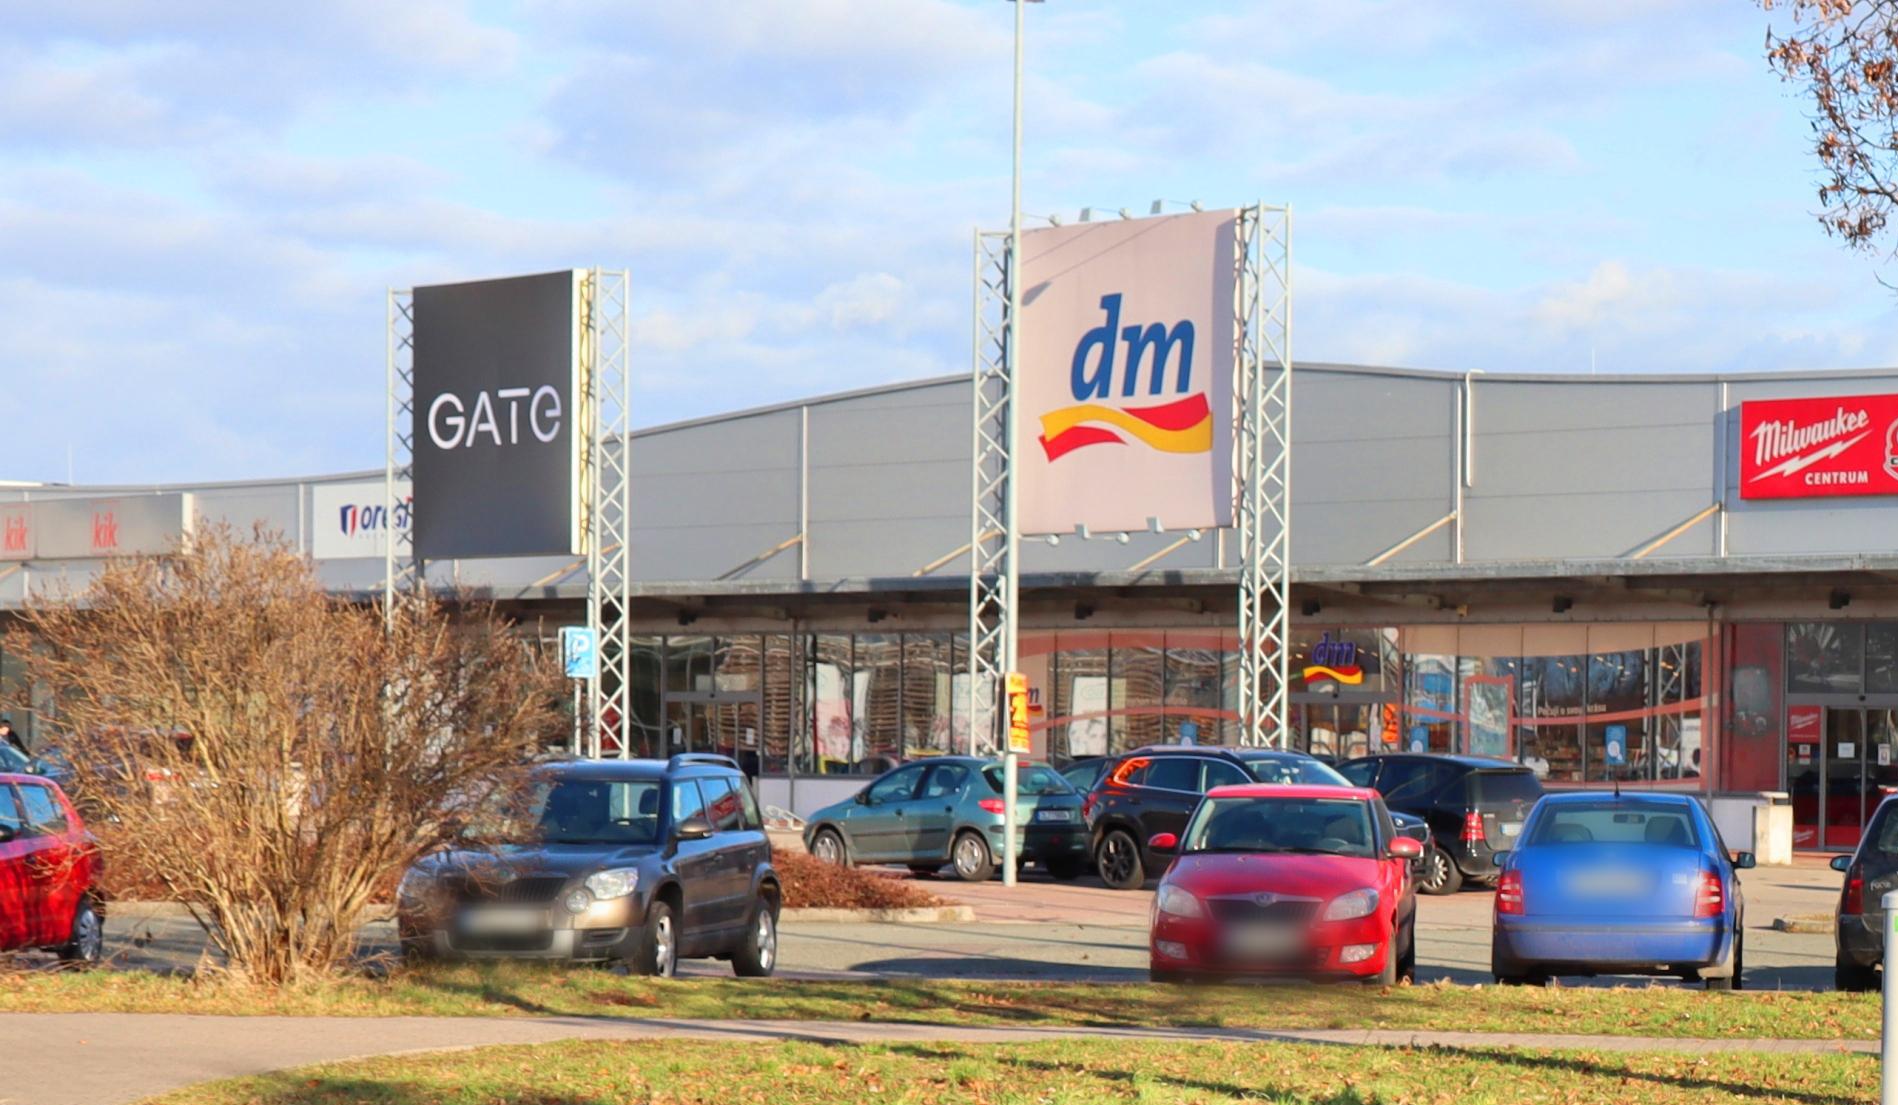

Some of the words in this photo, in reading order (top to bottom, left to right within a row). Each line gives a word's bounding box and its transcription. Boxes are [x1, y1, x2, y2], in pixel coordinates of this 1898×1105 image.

[1071, 292, 1195, 402] dm
[1750, 407, 1870, 467] Milwaukee
[1805, 470, 1869, 486] CENTRUM
[92, 511, 118, 548] kik
[1312, 631, 1356, 666] dm
